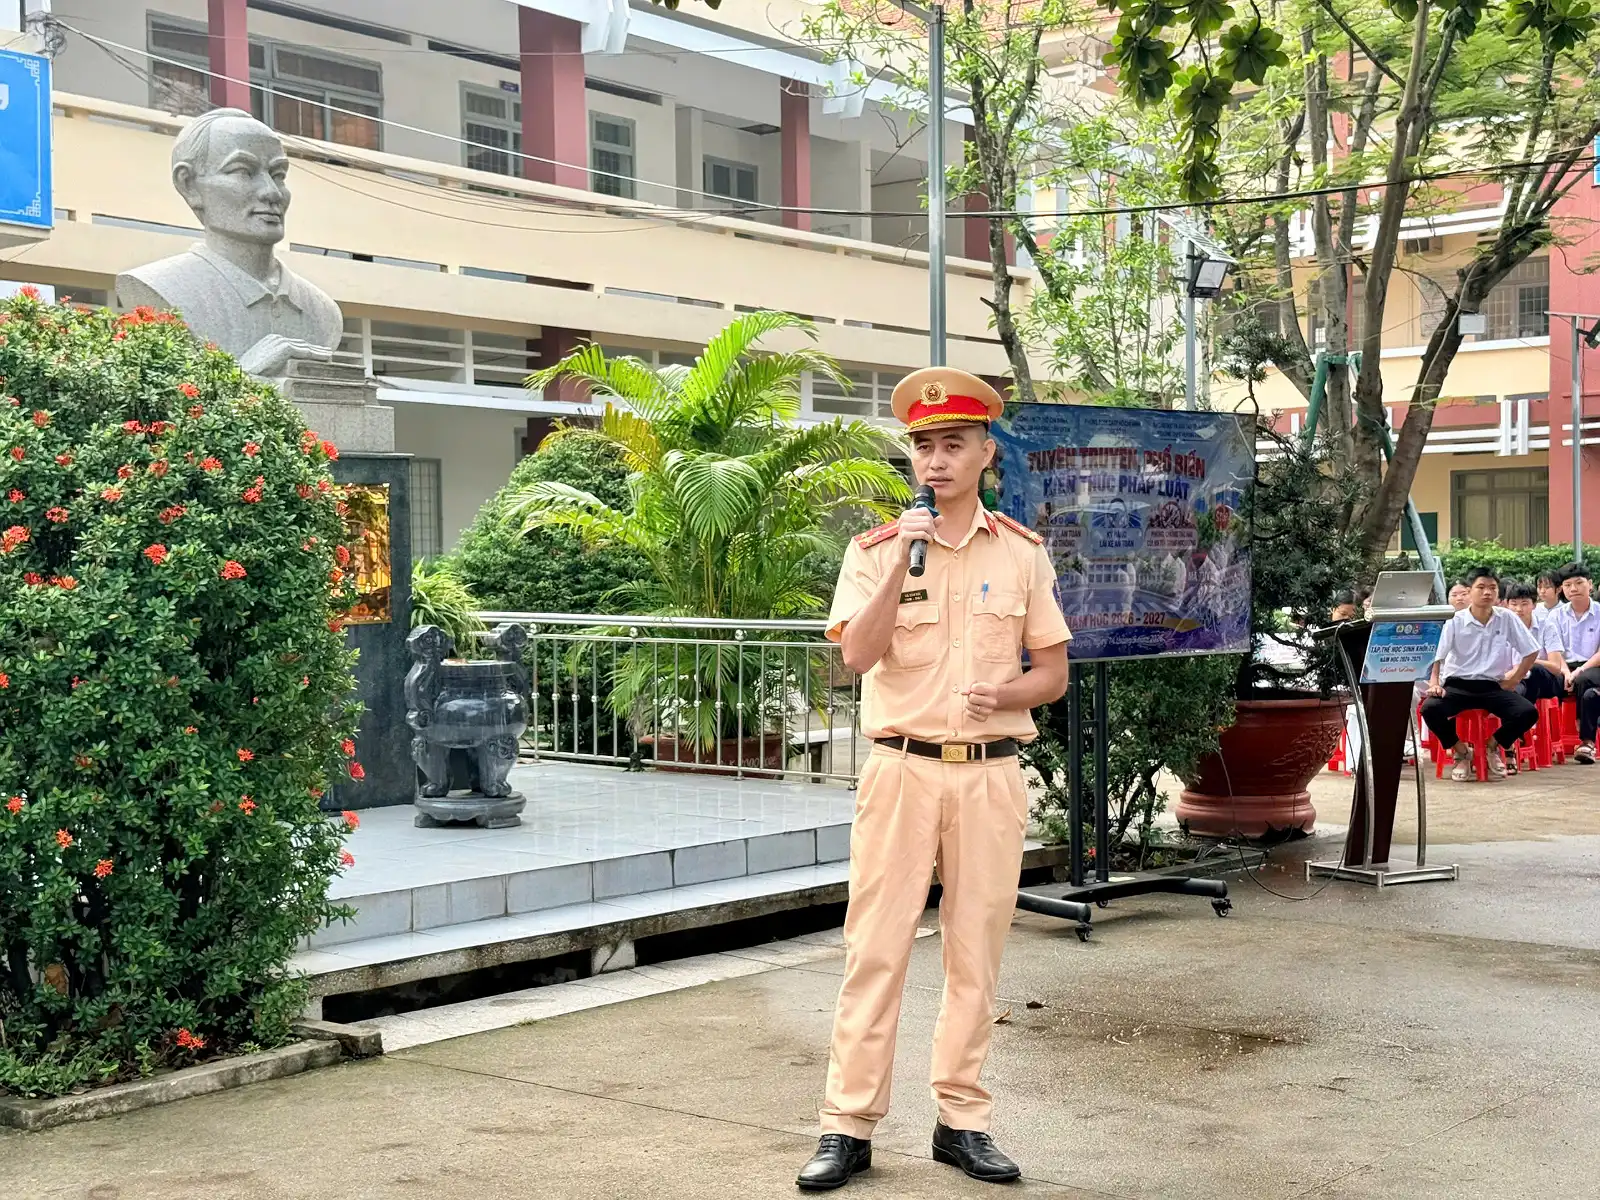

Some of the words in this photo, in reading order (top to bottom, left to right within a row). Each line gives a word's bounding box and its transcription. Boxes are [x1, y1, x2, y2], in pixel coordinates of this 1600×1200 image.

[1175, 449, 1205, 479] BIẾN
[1157, 474, 1190, 500] LUẬT
[1144, 611, 1166, 625] 2027
